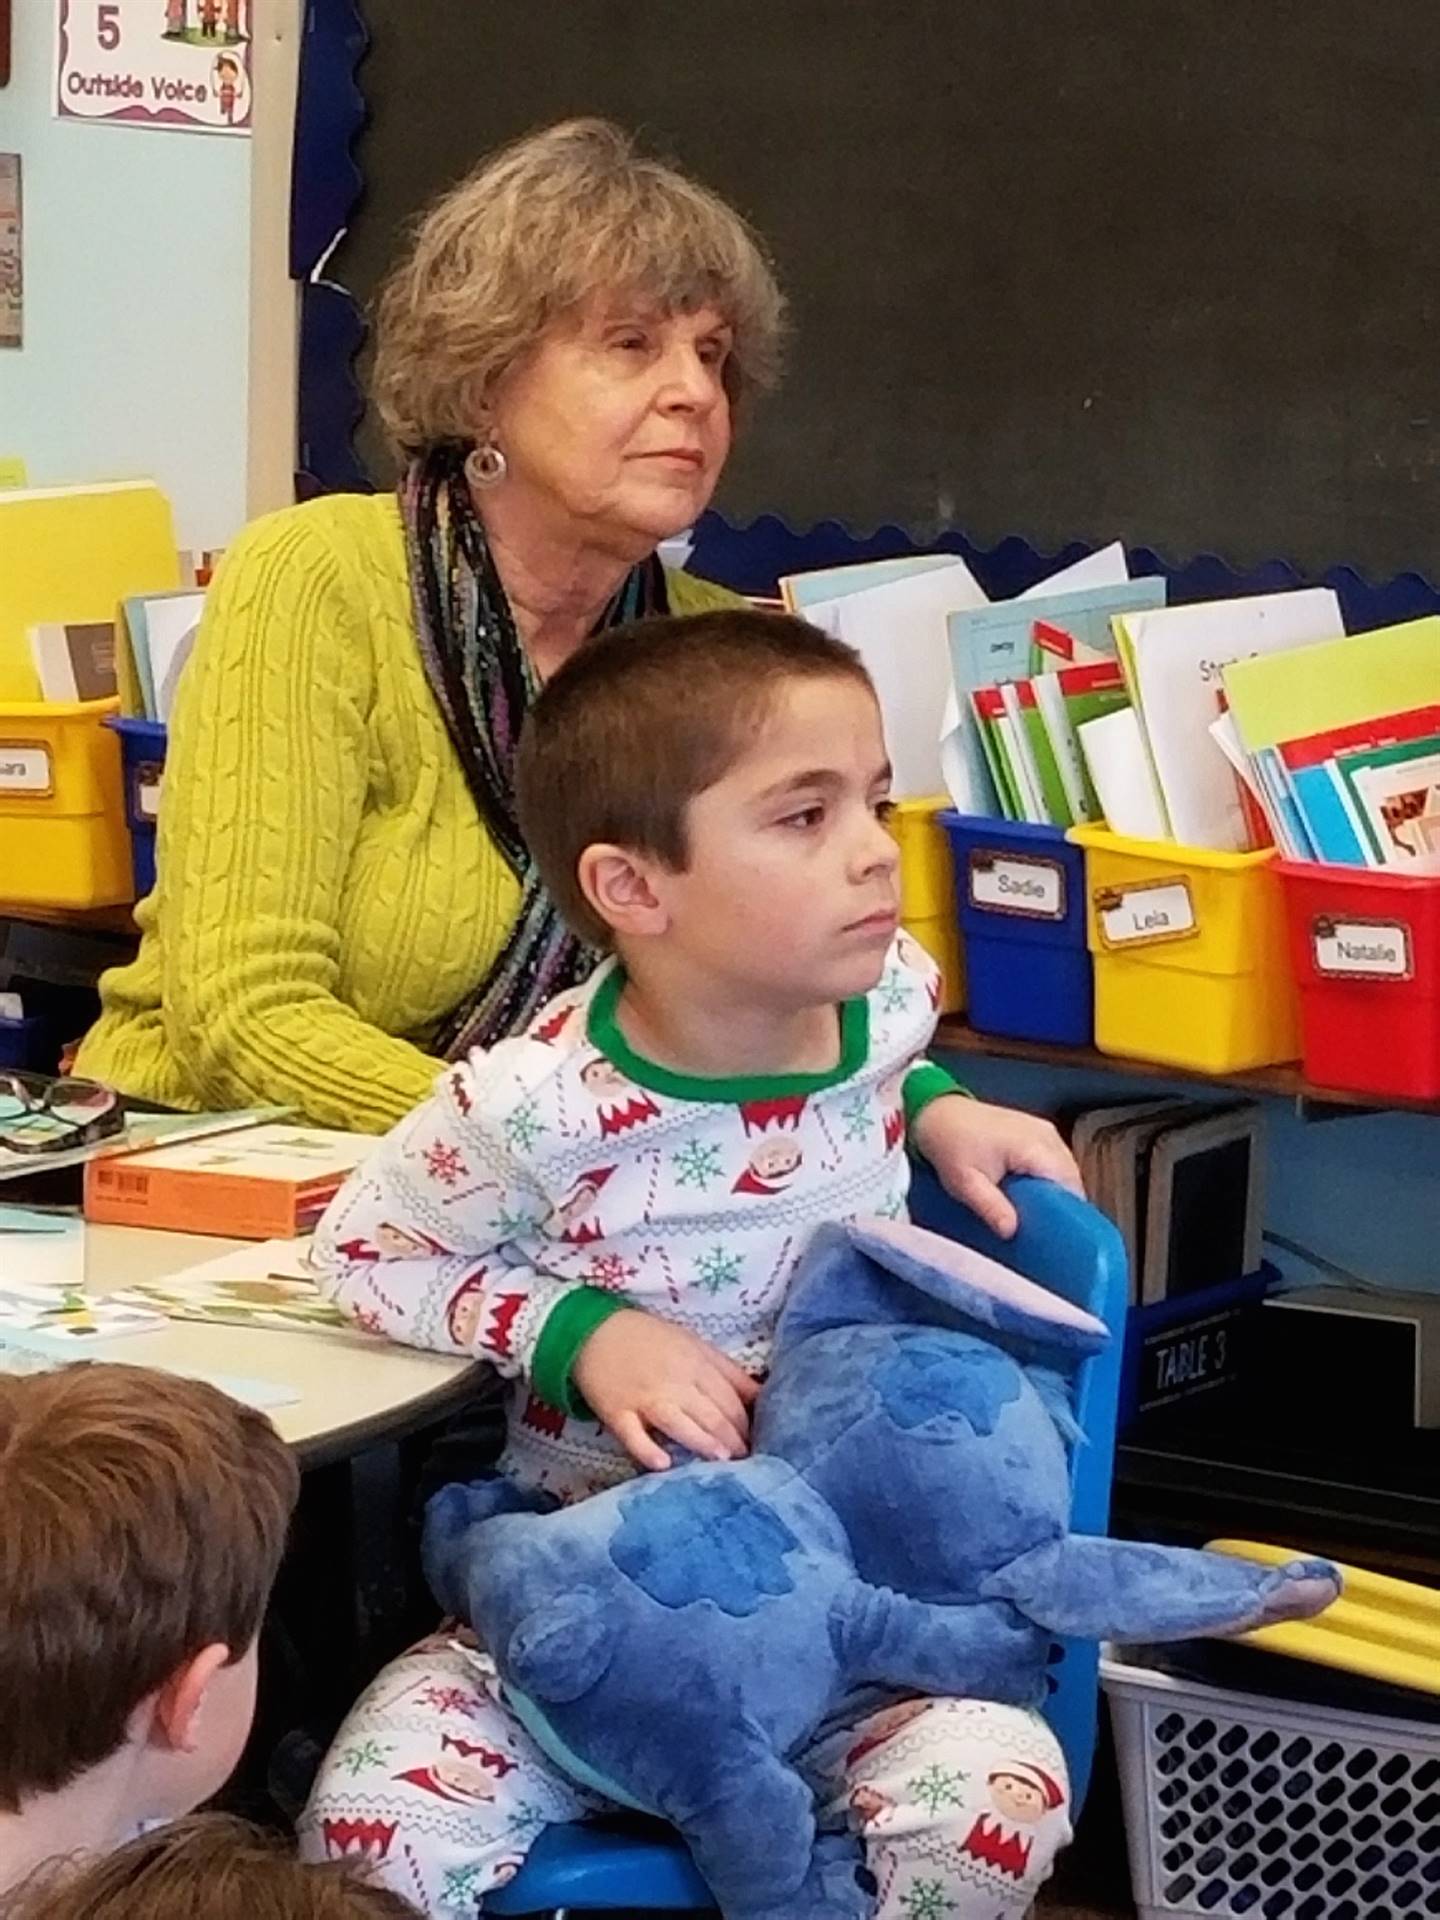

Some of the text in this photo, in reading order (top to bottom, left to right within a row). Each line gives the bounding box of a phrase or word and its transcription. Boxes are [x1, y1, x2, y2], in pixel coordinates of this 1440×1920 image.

[97, 4, 121, 50] 5
[67, 71, 208, 103] Outside Voice
[998, 874, 1045, 899] Sadie
[1336, 941, 1396, 963] Natalie
[1156, 1329, 1226, 1389] TABLE 3
